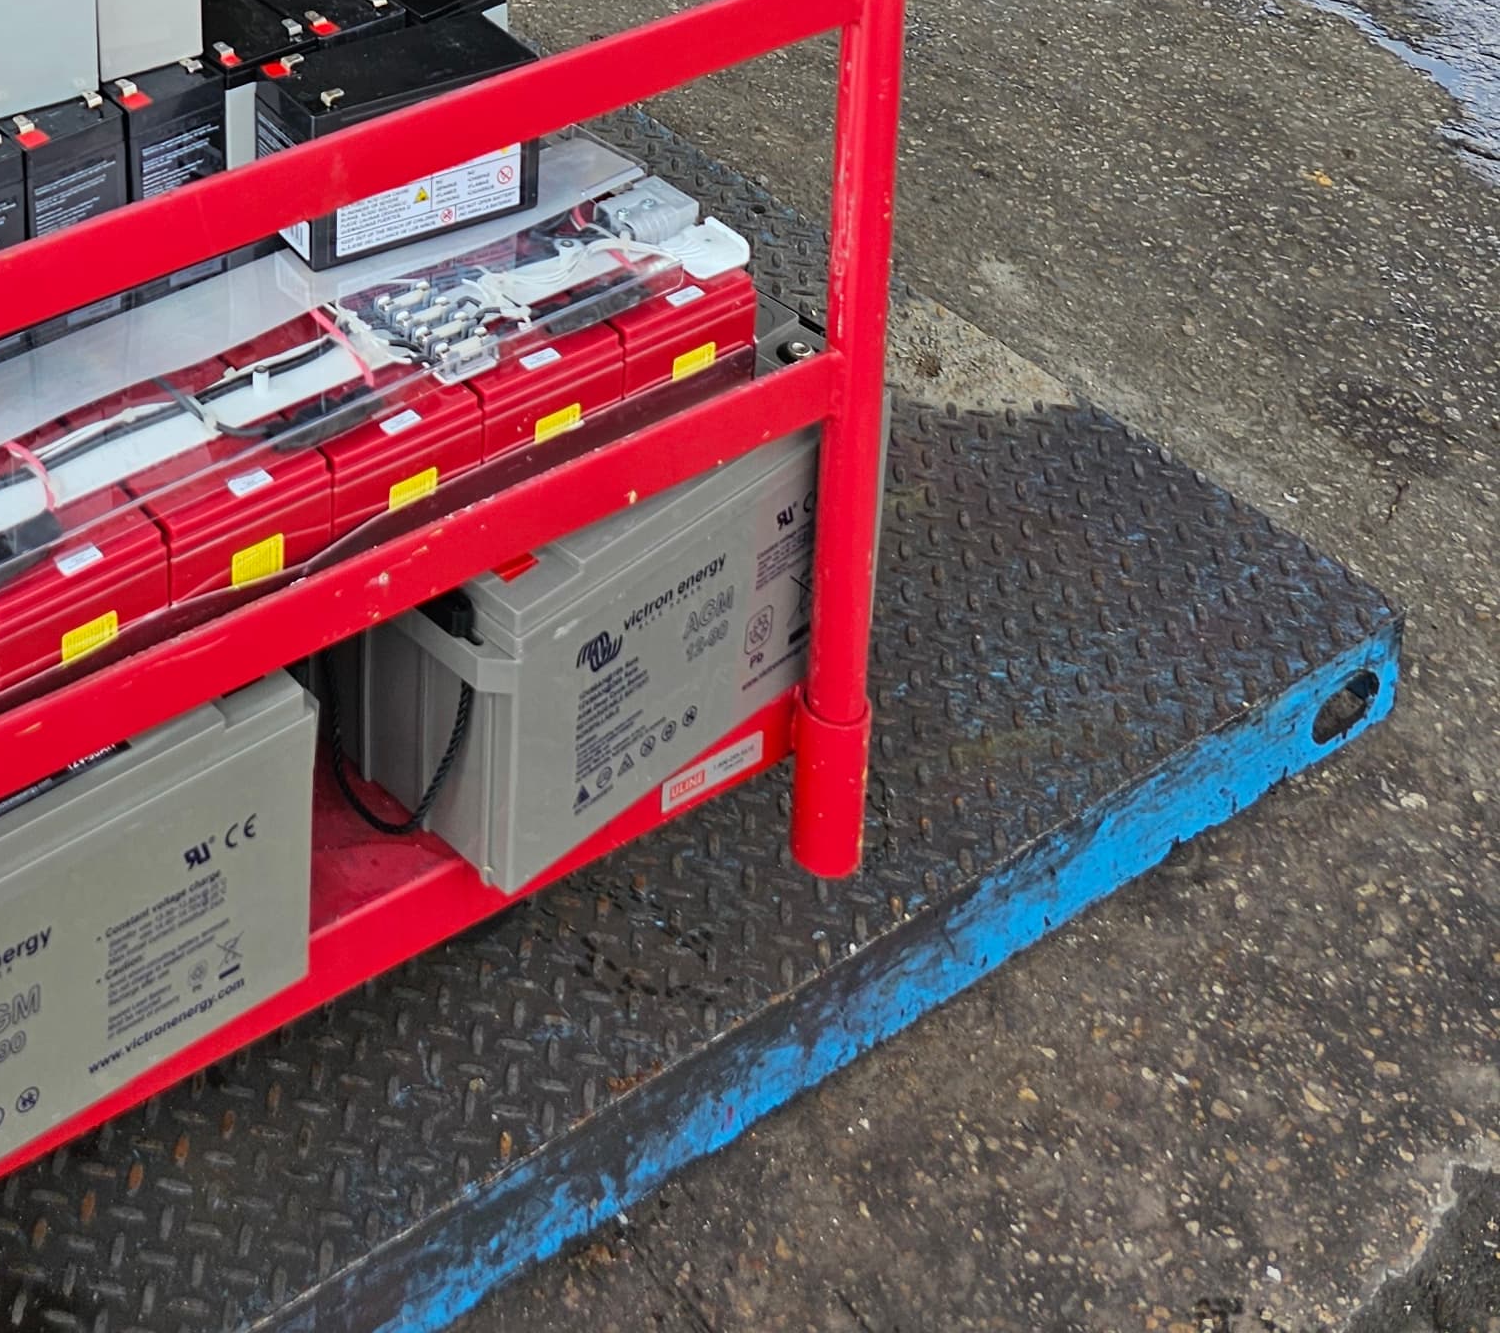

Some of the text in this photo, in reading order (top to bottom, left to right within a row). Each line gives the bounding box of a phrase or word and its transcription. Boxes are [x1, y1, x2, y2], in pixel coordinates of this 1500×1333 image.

[624, 587, 673, 632] victron
[677, 553, 726, 595] energy
[683, 585, 734, 640] AGM
[88, 978, 245, 1075] www.victronenergy.com
